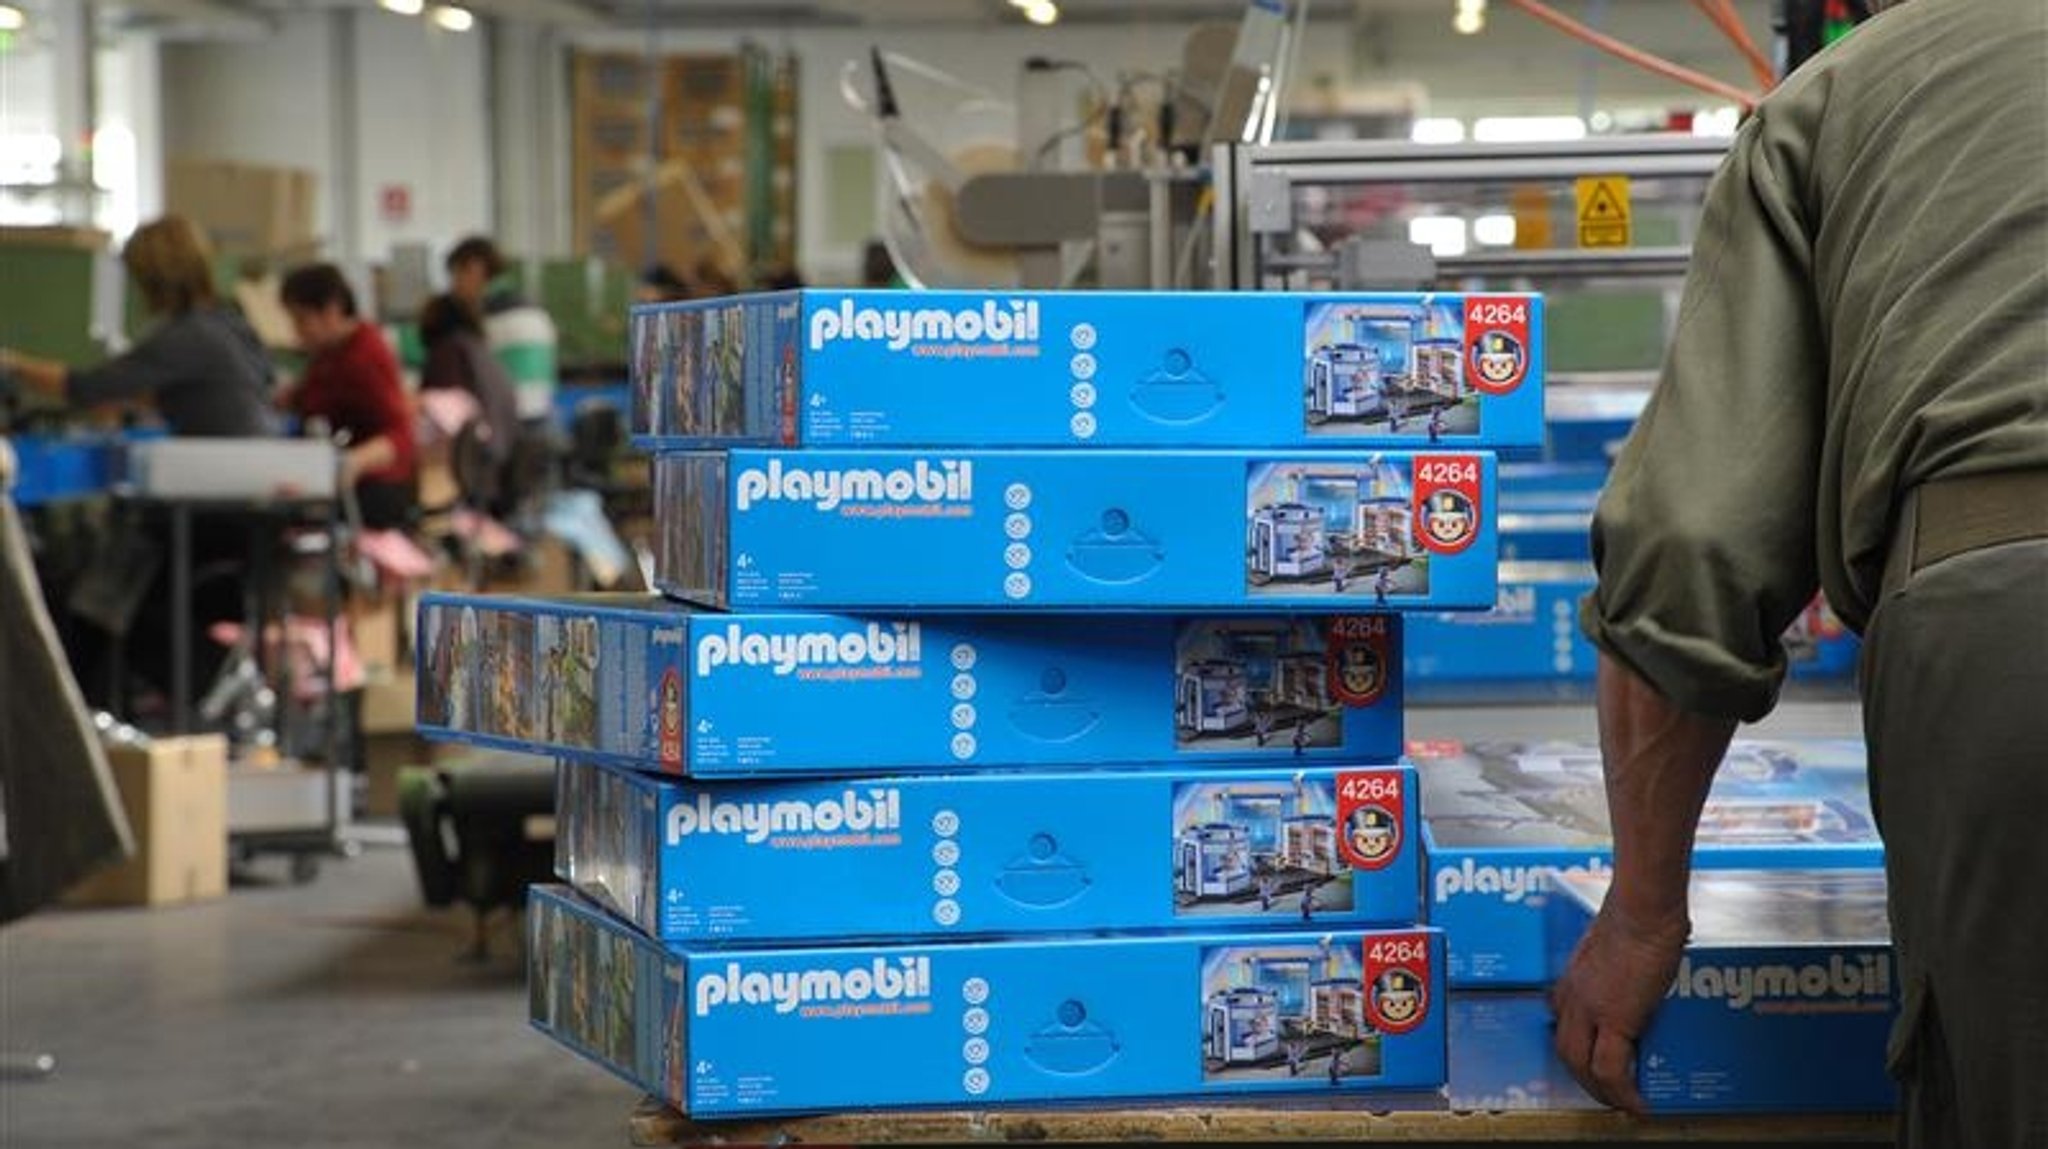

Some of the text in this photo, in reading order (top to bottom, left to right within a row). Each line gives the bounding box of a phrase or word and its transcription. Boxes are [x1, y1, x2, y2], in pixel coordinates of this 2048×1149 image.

[810, 298, 1039, 350] playmobil
[1470, 304, 1526, 324] 4264
[737, 458, 972, 511] playmobil
[1419, 463, 1477, 483] 4264
[697, 622, 921, 676] playmobil
[1332, 616, 1386, 637] 4264
[1342, 779, 1399, 799] 4264
[667, 788, 900, 845] playmobil
[1370, 940, 1427, 963] 4264
[696, 957, 930, 1016] playmobil
[1665, 954, 1890, 1009] laymobil
